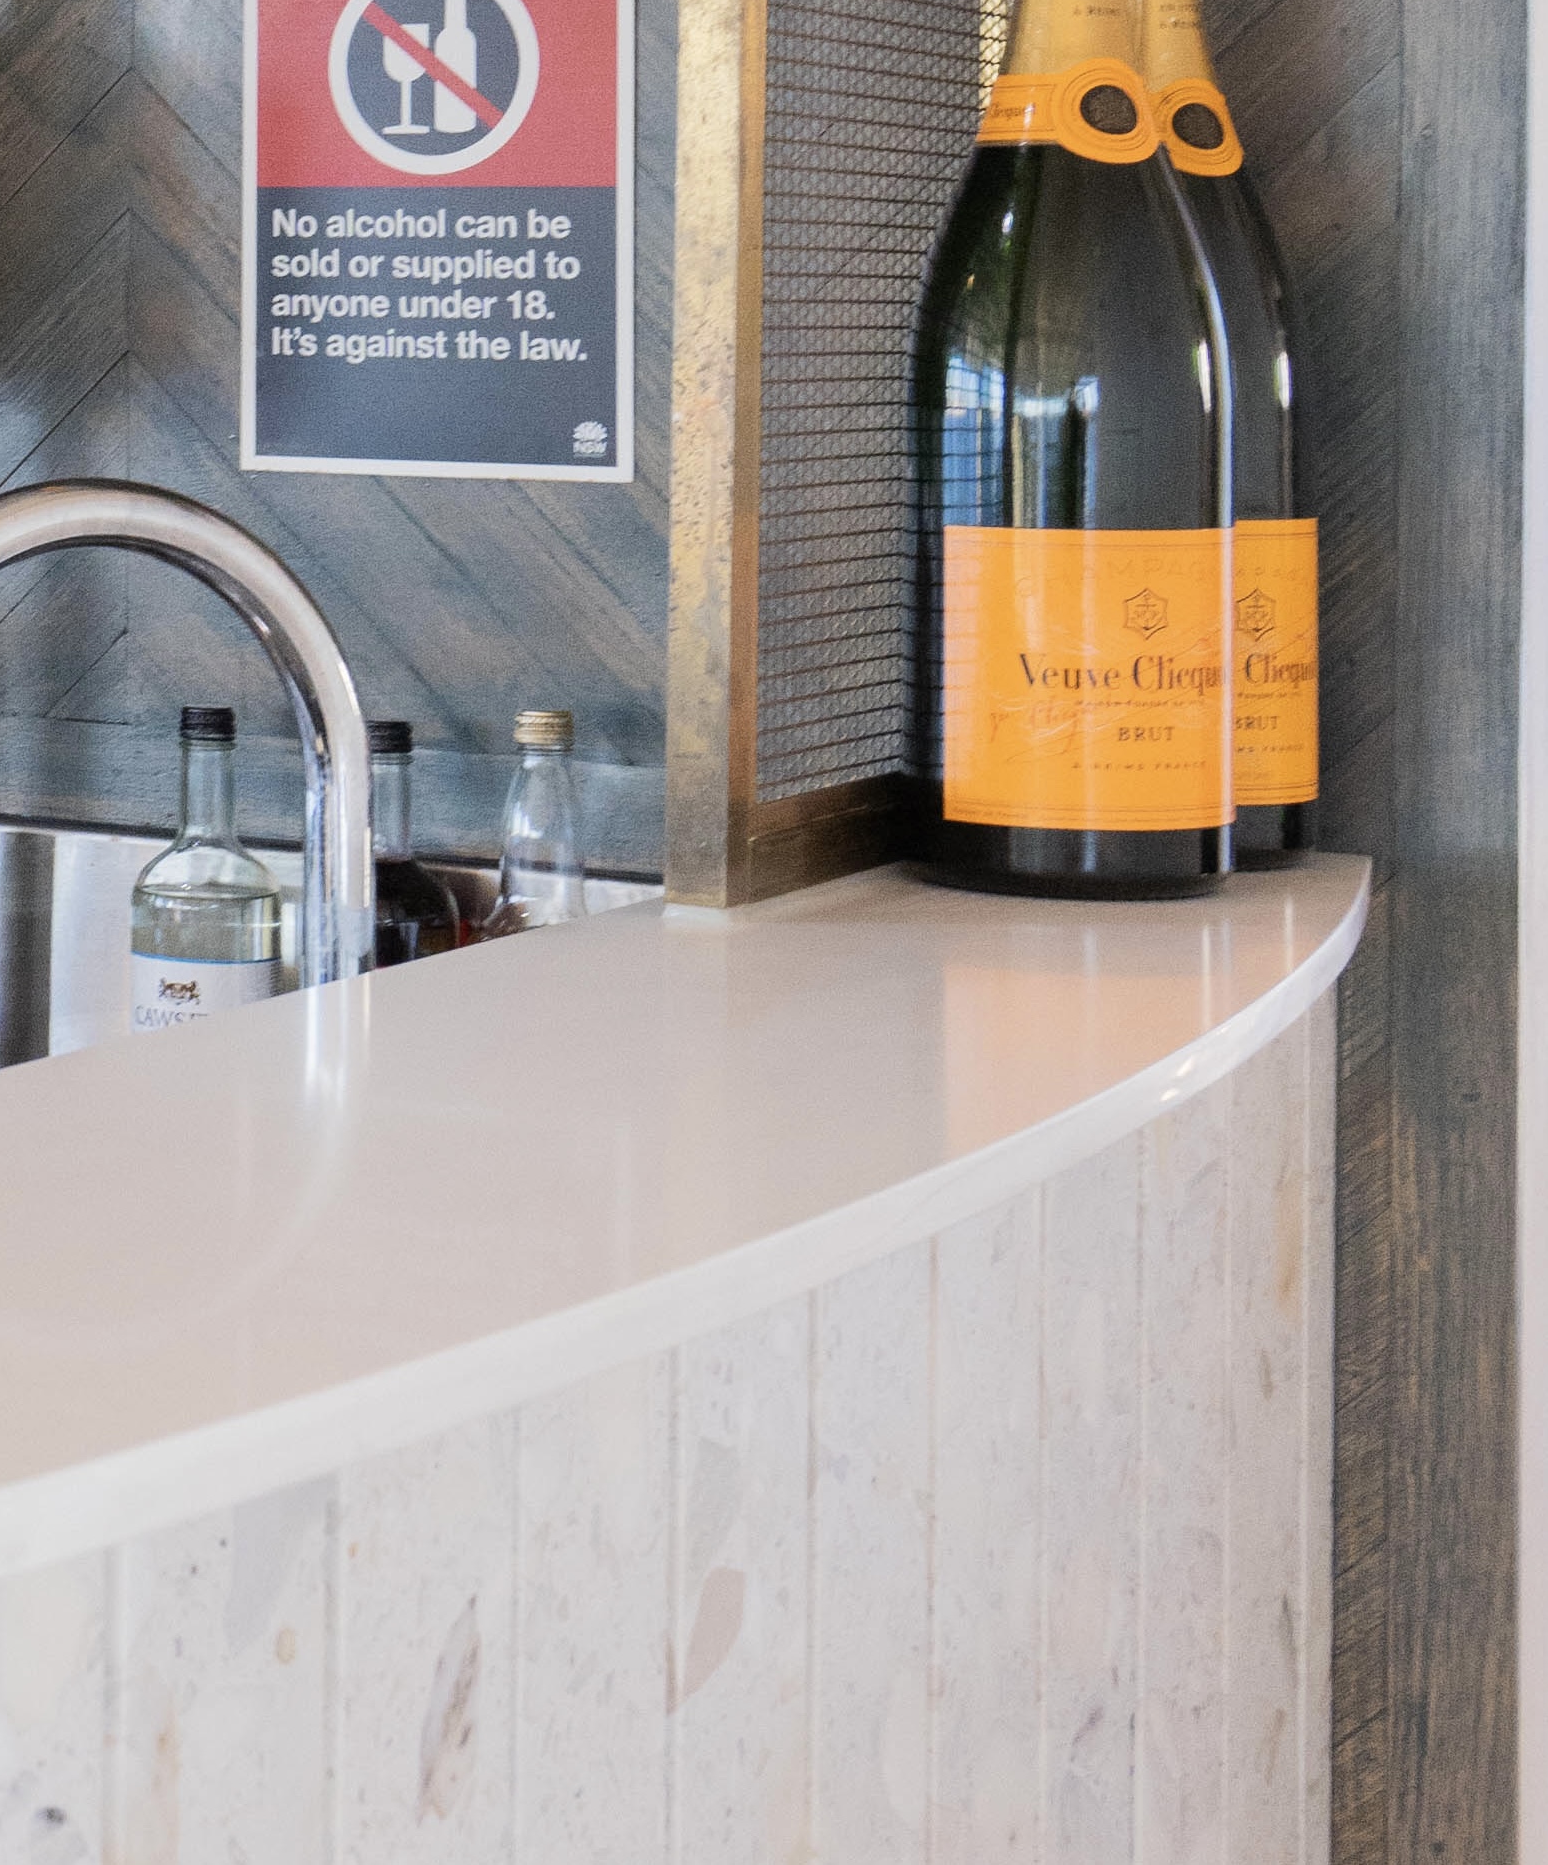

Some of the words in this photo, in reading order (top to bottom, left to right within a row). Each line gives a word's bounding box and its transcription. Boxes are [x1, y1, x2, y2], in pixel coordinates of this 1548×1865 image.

[271, 208, 318, 238] No
[326, 208, 447, 239] alcohol
[455, 214, 518, 239] can
[527, 208, 572, 240] be
[271, 248, 340, 278] sold
[348, 255, 385, 278] or
[391, 248, 536, 285] supplied
[543, 252, 581, 280] to
[271, 293, 390, 324] anyone
[399, 290, 498, 320] under
[506, 290, 556, 321] 18.
[271, 327, 318, 356] It's
[325, 328, 449, 365] against
[455, 330, 512, 361] the
[519, 330, 588, 362] law.
[1019, 652, 1120, 691] Veuve
[1117, 725, 1175, 742] BRUT
